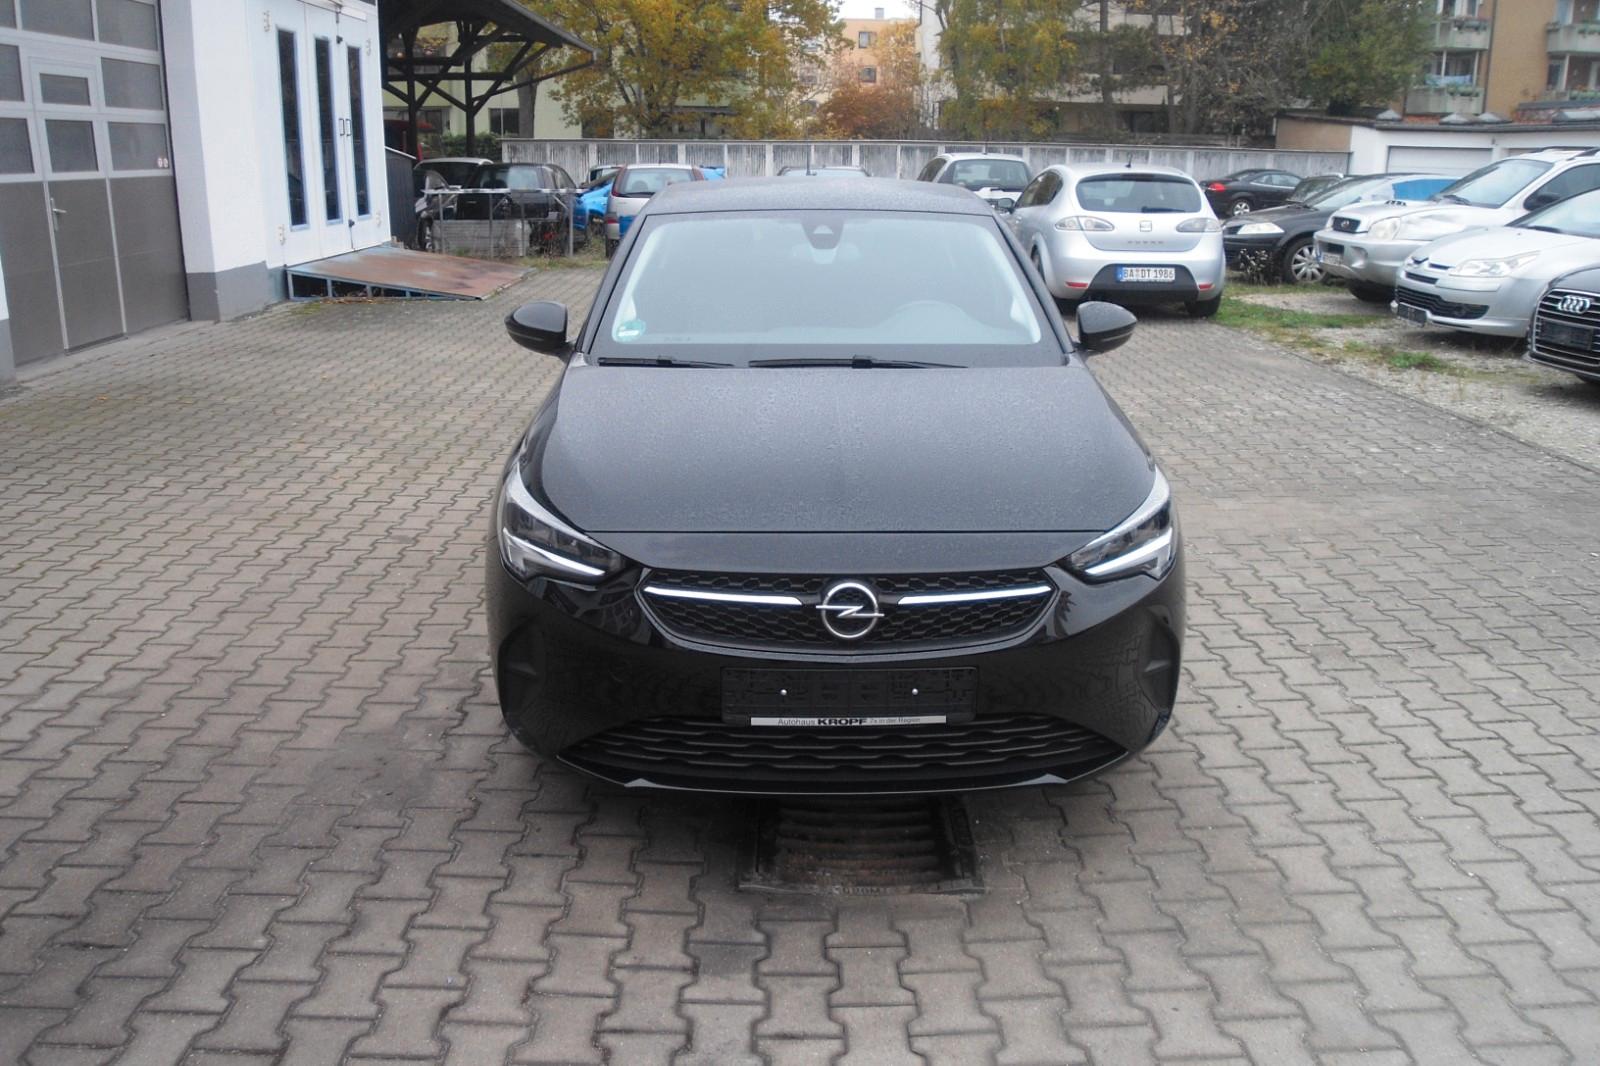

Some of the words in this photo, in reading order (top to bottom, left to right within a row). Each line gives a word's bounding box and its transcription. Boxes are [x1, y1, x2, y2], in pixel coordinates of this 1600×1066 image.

[1123, 268, 1134, 279] BA
[778, 718, 815, 726] Autohaus
[817, 717, 868, 726] KROPF
